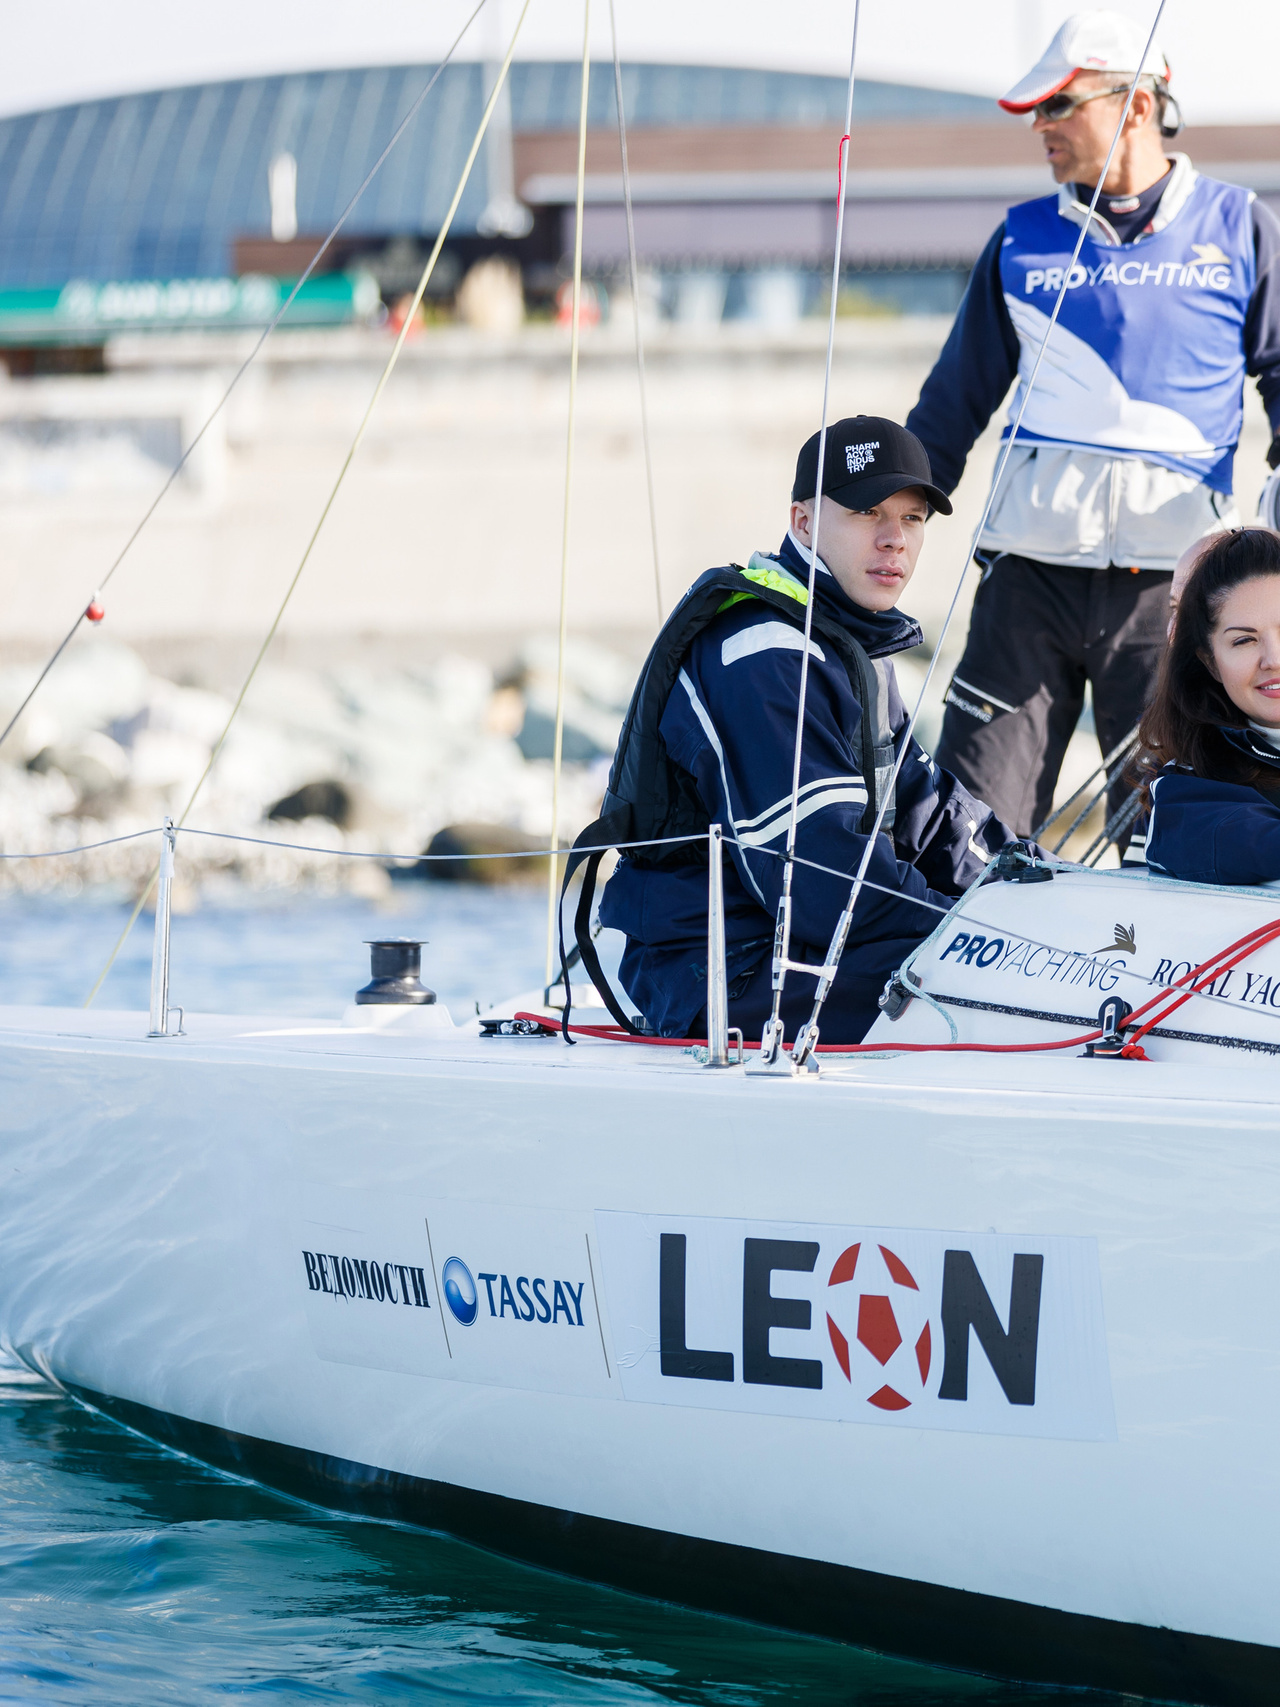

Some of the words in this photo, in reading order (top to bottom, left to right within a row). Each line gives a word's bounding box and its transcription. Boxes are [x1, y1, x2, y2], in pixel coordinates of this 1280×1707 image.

[1025, 261, 1232, 295] PROYACHTING
[845, 441, 880, 453] PHARM
[846, 455, 875, 467] INDUS
[847, 463, 866, 474] TRY
[939, 932, 1127, 992] PROYACHTING
[302, 1250, 431, 1309] ВЕДОМОСТИ
[477, 1272, 585, 1327] TASSAY
